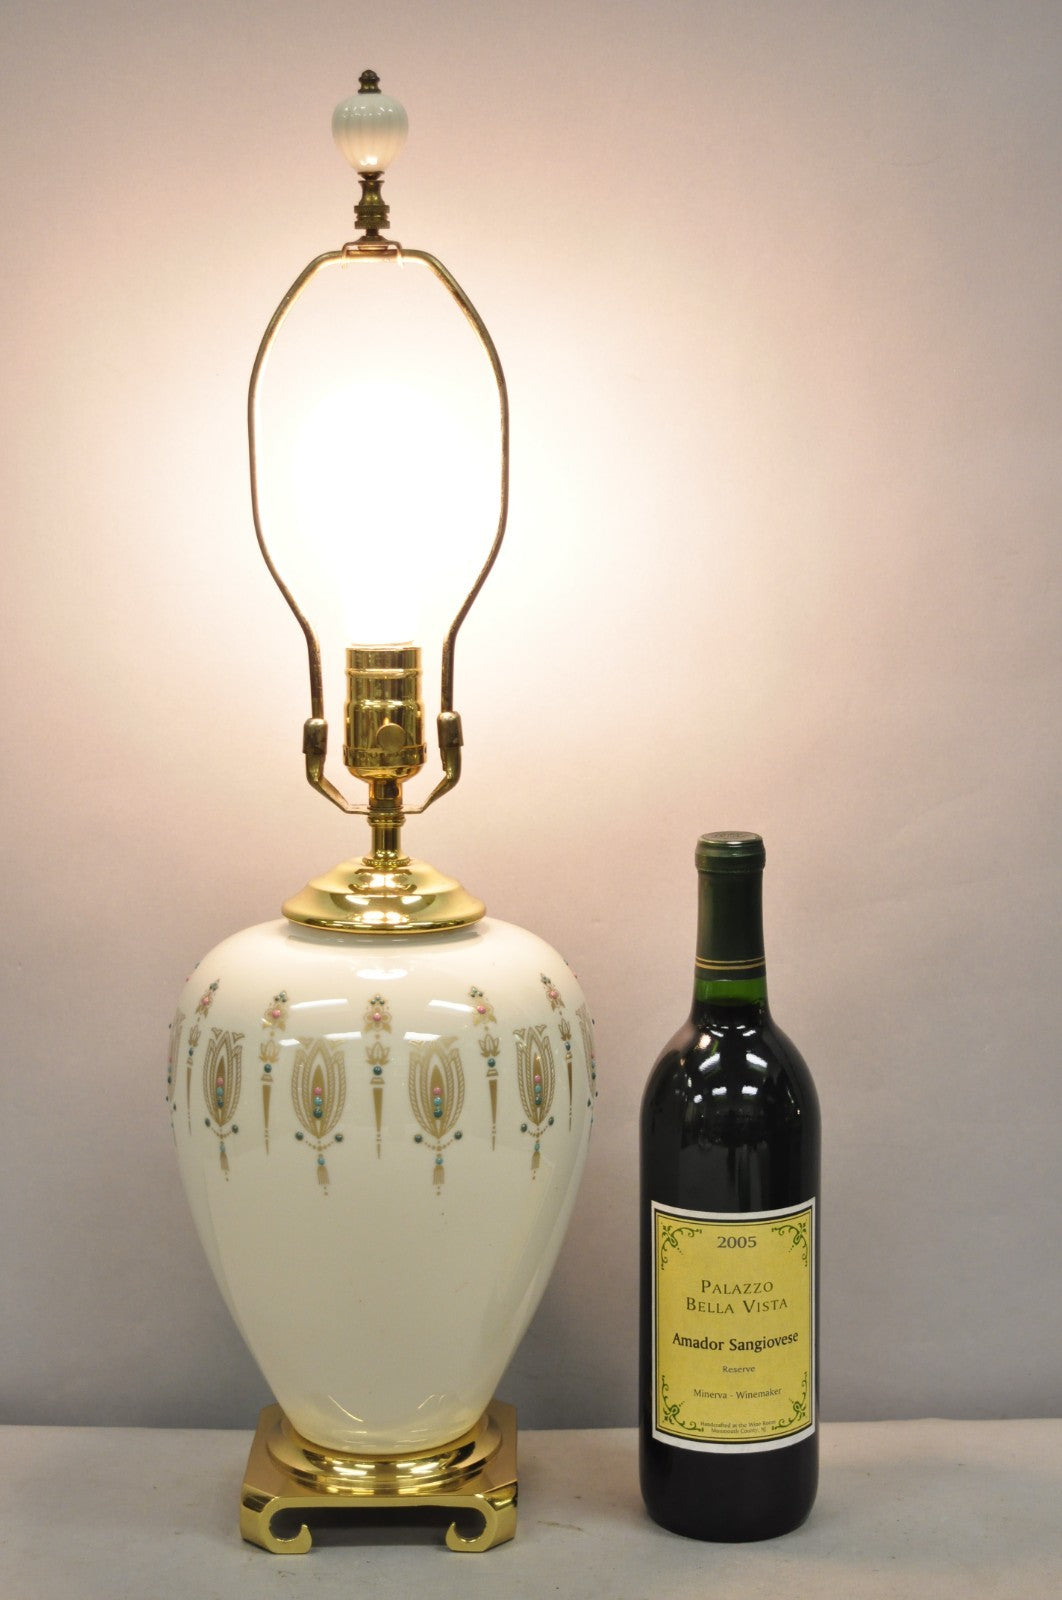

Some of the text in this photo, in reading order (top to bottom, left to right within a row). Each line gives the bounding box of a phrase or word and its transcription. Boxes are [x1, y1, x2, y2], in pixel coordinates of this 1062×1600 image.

[717, 1236, 757, 1249] 2005
[701, 1279, 774, 1295] PALAZZO
[686, 1296, 788, 1314] BELLA VISTA
[672, 1331, 799, 1353] Amador Sangiovese
[722, 1365, 756, 1373] Reserve
[693, 1388, 727, 1399] Minerva
[736, 1387, 782, 1399] Winemaker
